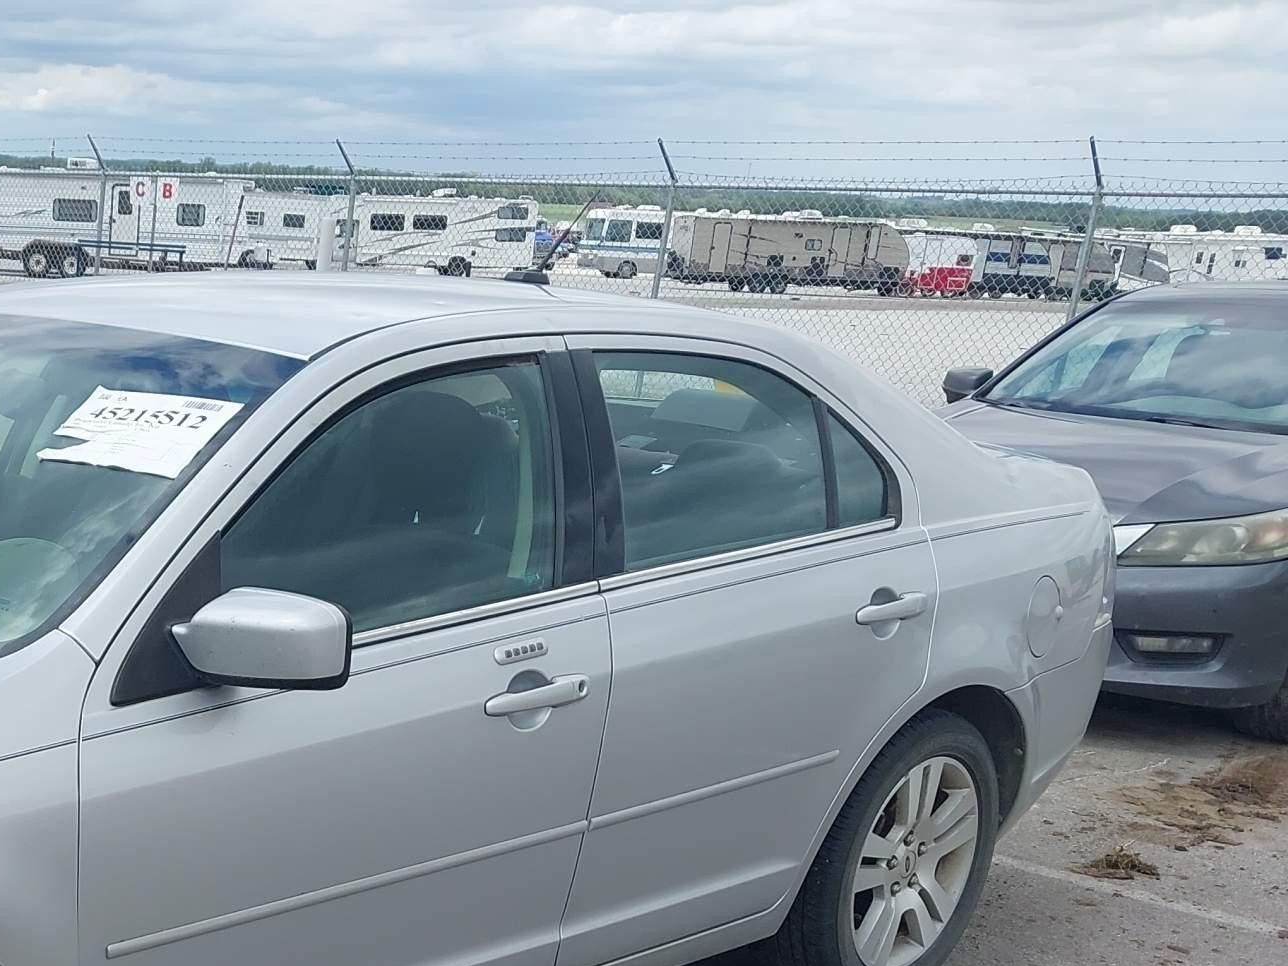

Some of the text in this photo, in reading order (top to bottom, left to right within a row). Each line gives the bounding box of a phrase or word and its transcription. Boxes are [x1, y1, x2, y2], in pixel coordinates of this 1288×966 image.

[136, 181, 145, 197] C
[163, 183, 173, 199] B
[90, 406, 208, 429] 45215512
